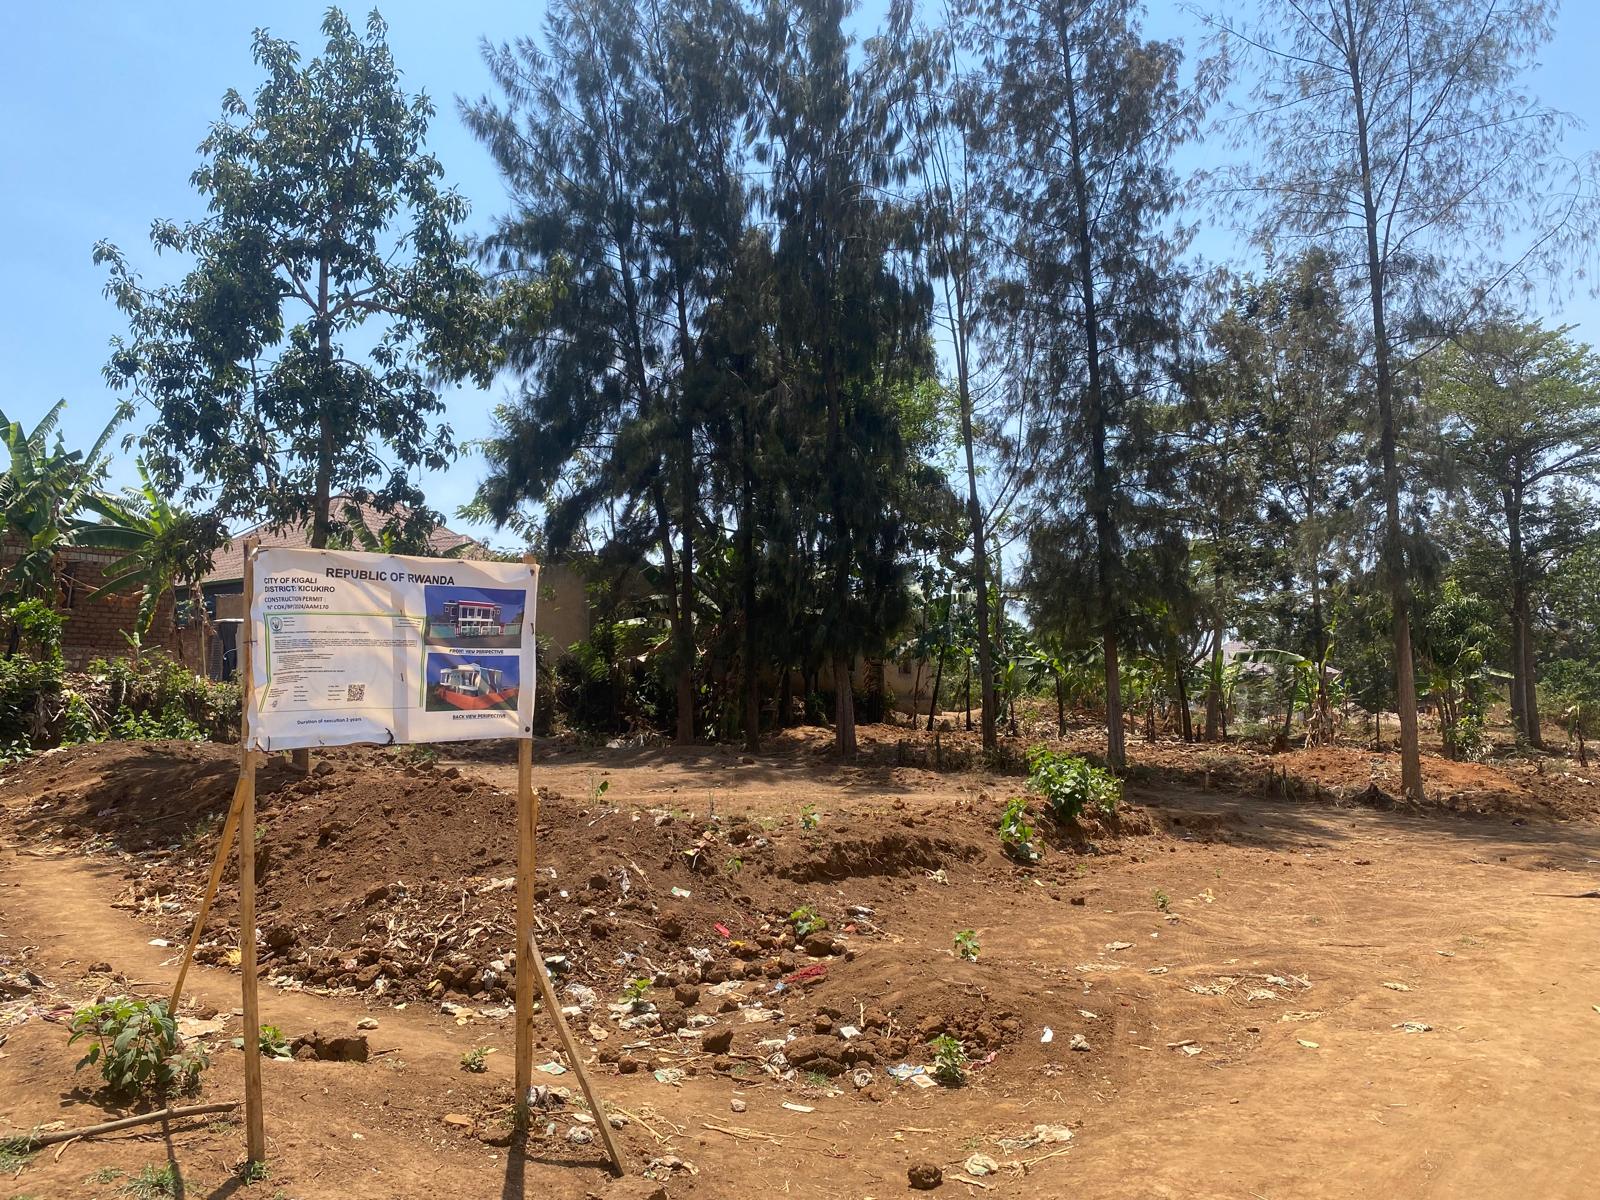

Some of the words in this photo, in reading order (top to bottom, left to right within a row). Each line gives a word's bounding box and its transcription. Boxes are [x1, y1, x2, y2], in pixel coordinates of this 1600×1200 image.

[325, 567, 387, 581] REPUBLIC
[390, 572, 405, 582] OF
[407, 573, 455, 586] RWANDA
